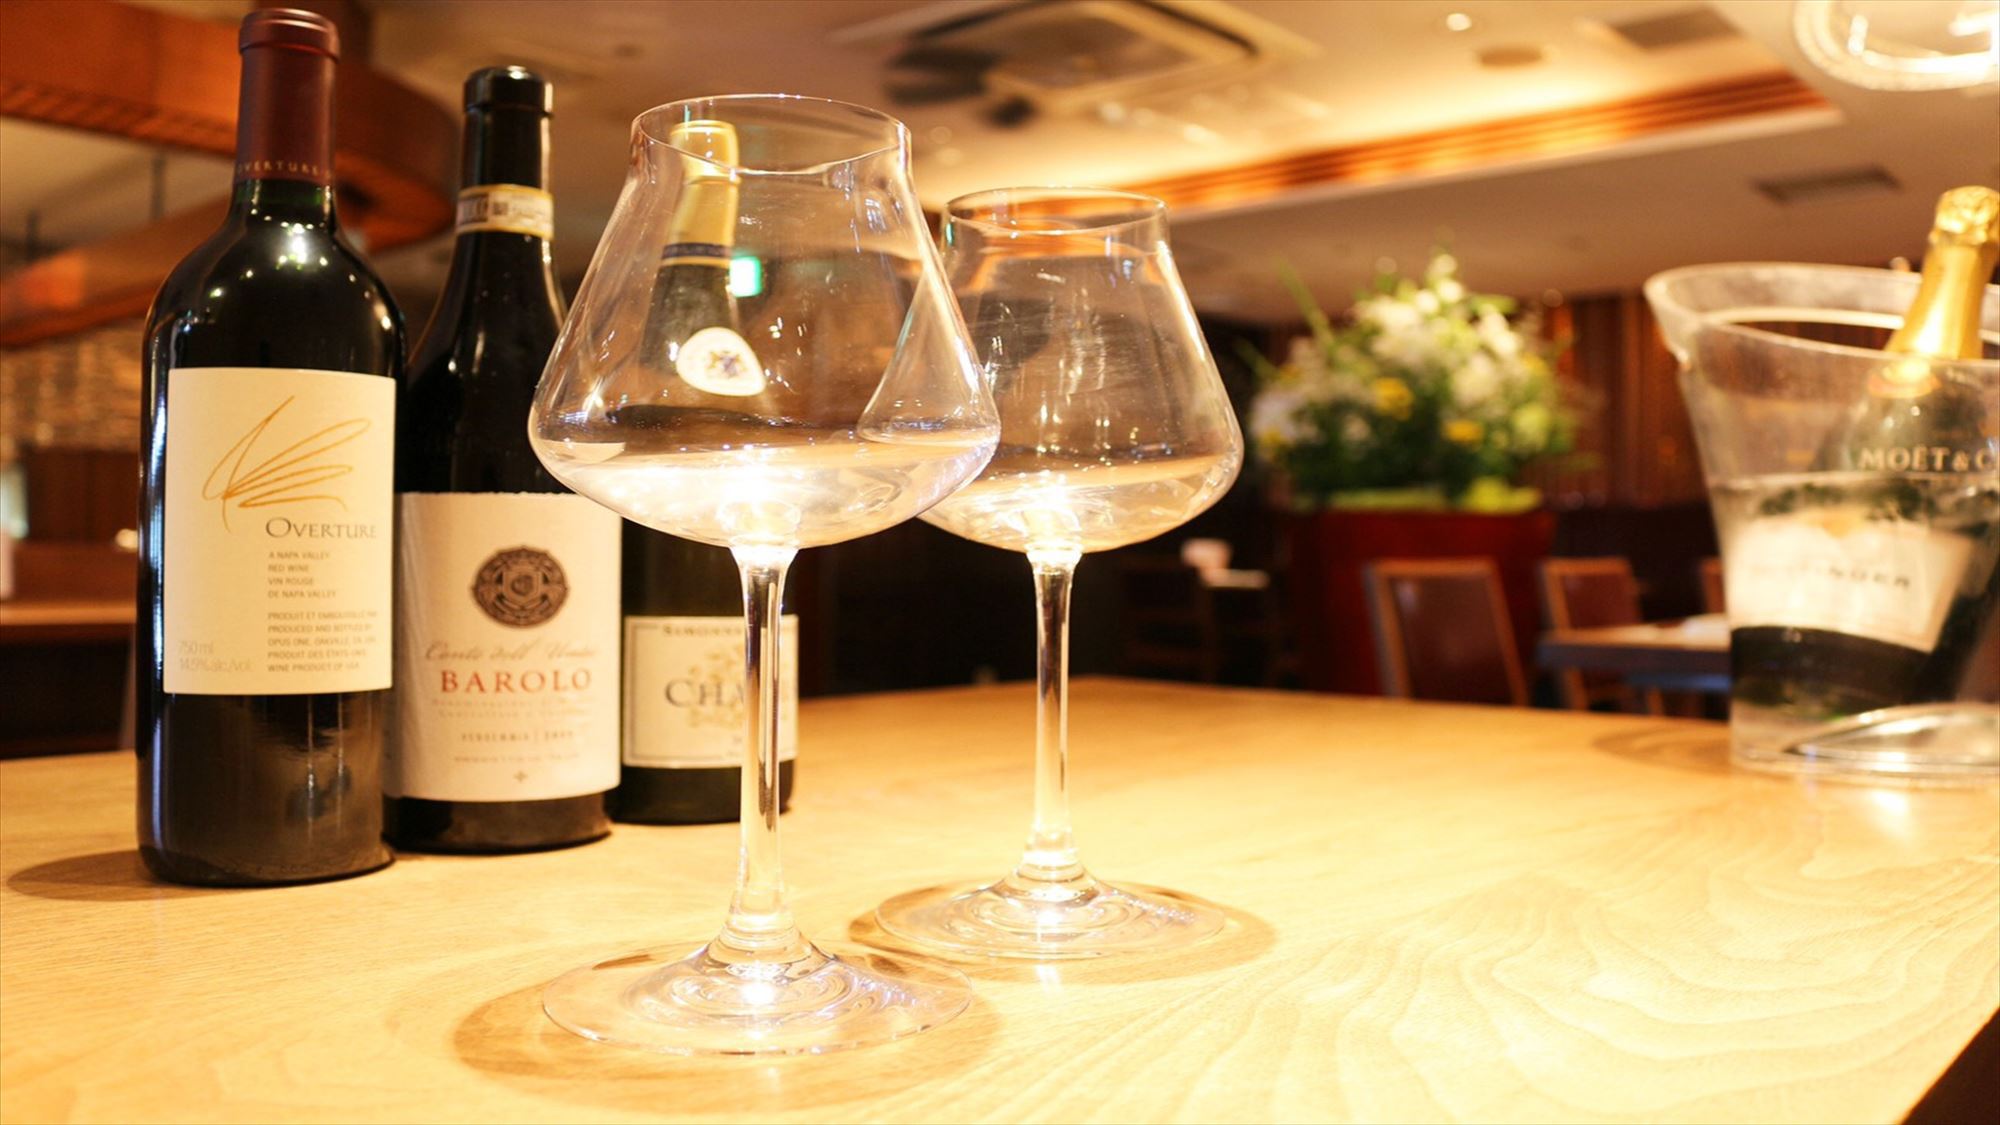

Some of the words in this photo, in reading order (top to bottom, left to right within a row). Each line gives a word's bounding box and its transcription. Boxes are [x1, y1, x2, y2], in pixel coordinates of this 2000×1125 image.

[265, 516, 377, 539] OVERTURE
[276, 551, 300, 559] NAPA
[302, 551, 330, 560] VALLEY
[268, 564, 285, 572] RED
[287, 564, 309, 572] WINE
[268, 577, 284, 586] VIN
[285, 577, 314, 586] ROUGE
[268, 590, 279, 599] DE
[282, 590, 305, 599] NAPA
[307, 590, 336, 599] VALLEY
[268, 612, 304, 620] PRODUIT
[268, 624, 313, 633] PRODUCED
[268, 638, 291, 646] OPUS
[268, 651, 304, 659] PRODUIT
[268, 663, 289, 672] WINE
[292, 662, 331, 672] PRODUCT
[441, 669, 592, 694] BAROLO
